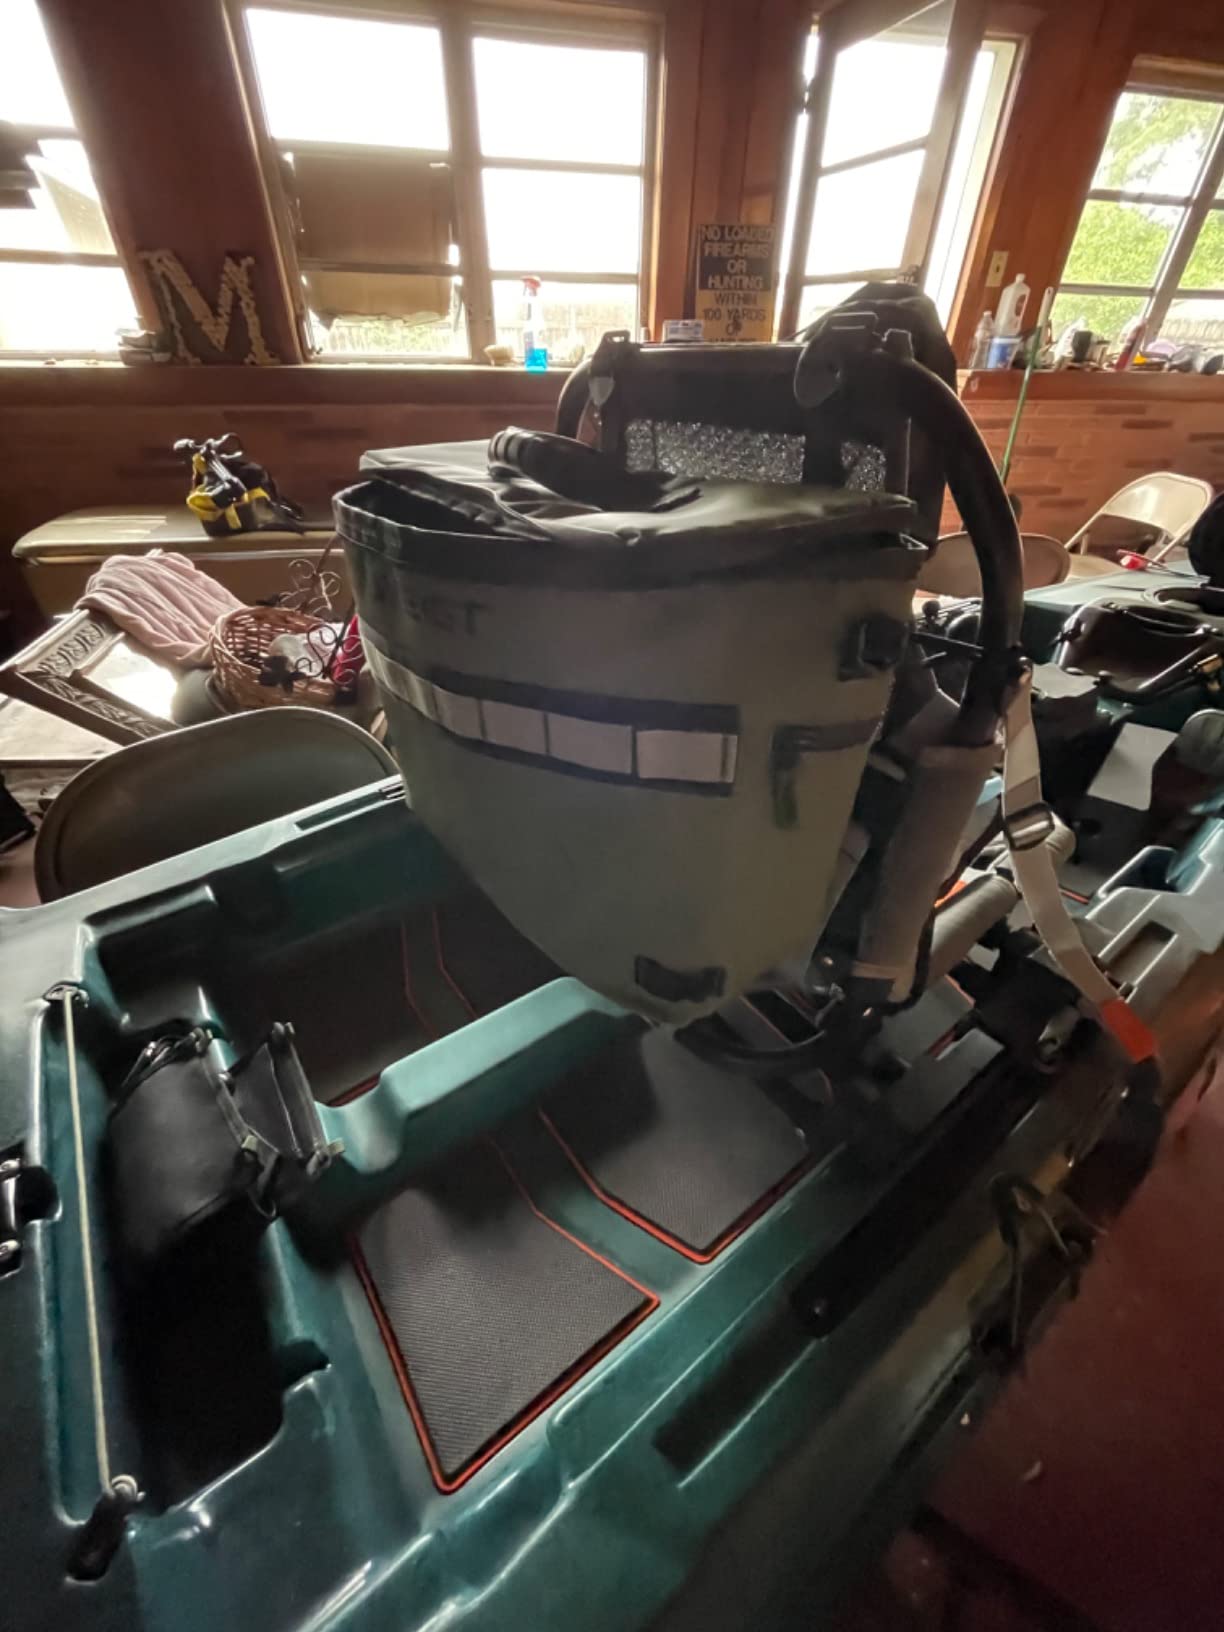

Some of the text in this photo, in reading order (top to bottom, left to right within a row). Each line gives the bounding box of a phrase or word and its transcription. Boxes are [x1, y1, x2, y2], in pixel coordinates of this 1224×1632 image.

[701, 226, 774, 242] NO LOADED
[704, 242, 769, 257] FIREARMS
[727, 259, 747, 274] OR
[708, 275, 763, 290] HUNTING
[714, 292, 757, 306] WITHIN
[138, 250, 281, 364] M
[703, 308, 766, 321] 100 YARDS
